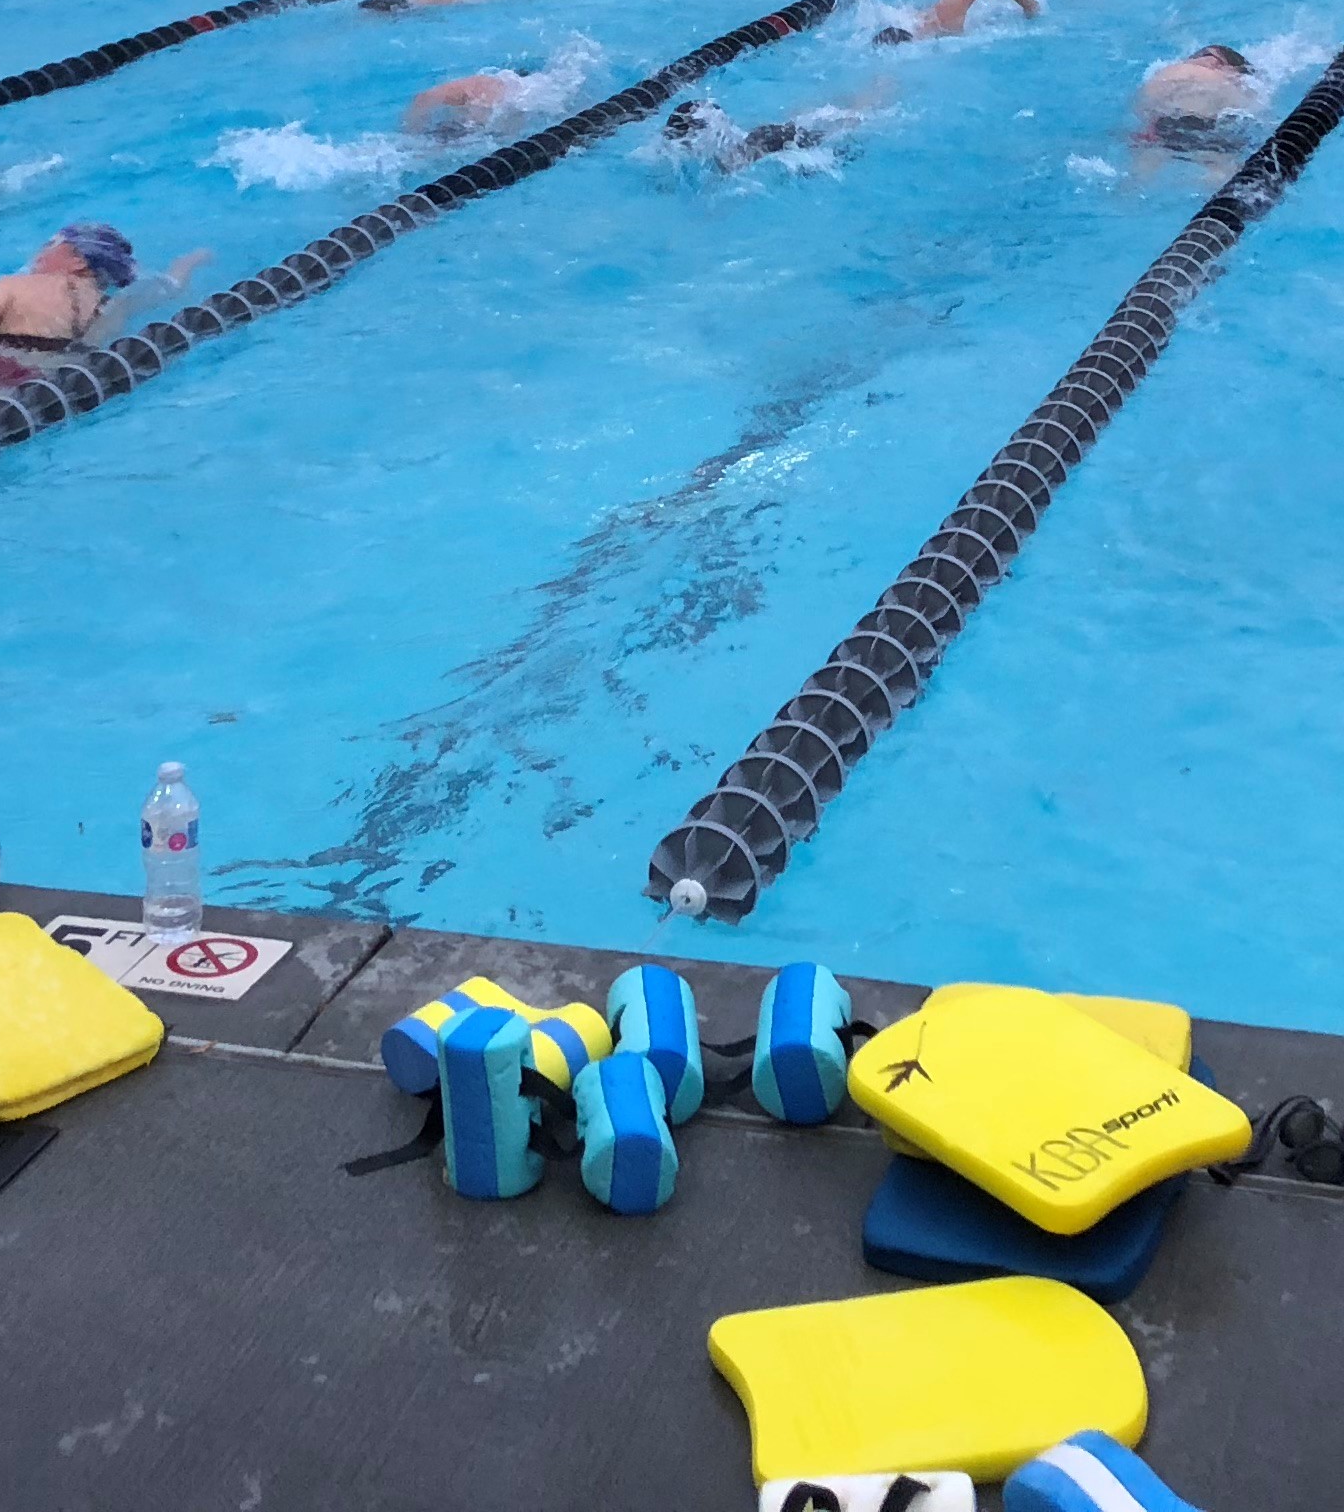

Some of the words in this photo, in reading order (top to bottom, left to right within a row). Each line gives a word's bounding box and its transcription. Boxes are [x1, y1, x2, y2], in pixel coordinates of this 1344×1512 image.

[139, 976, 165, 986] NO
[169, 979, 226, 993] DIVING
[1102, 1088, 1181, 1135] sporti
